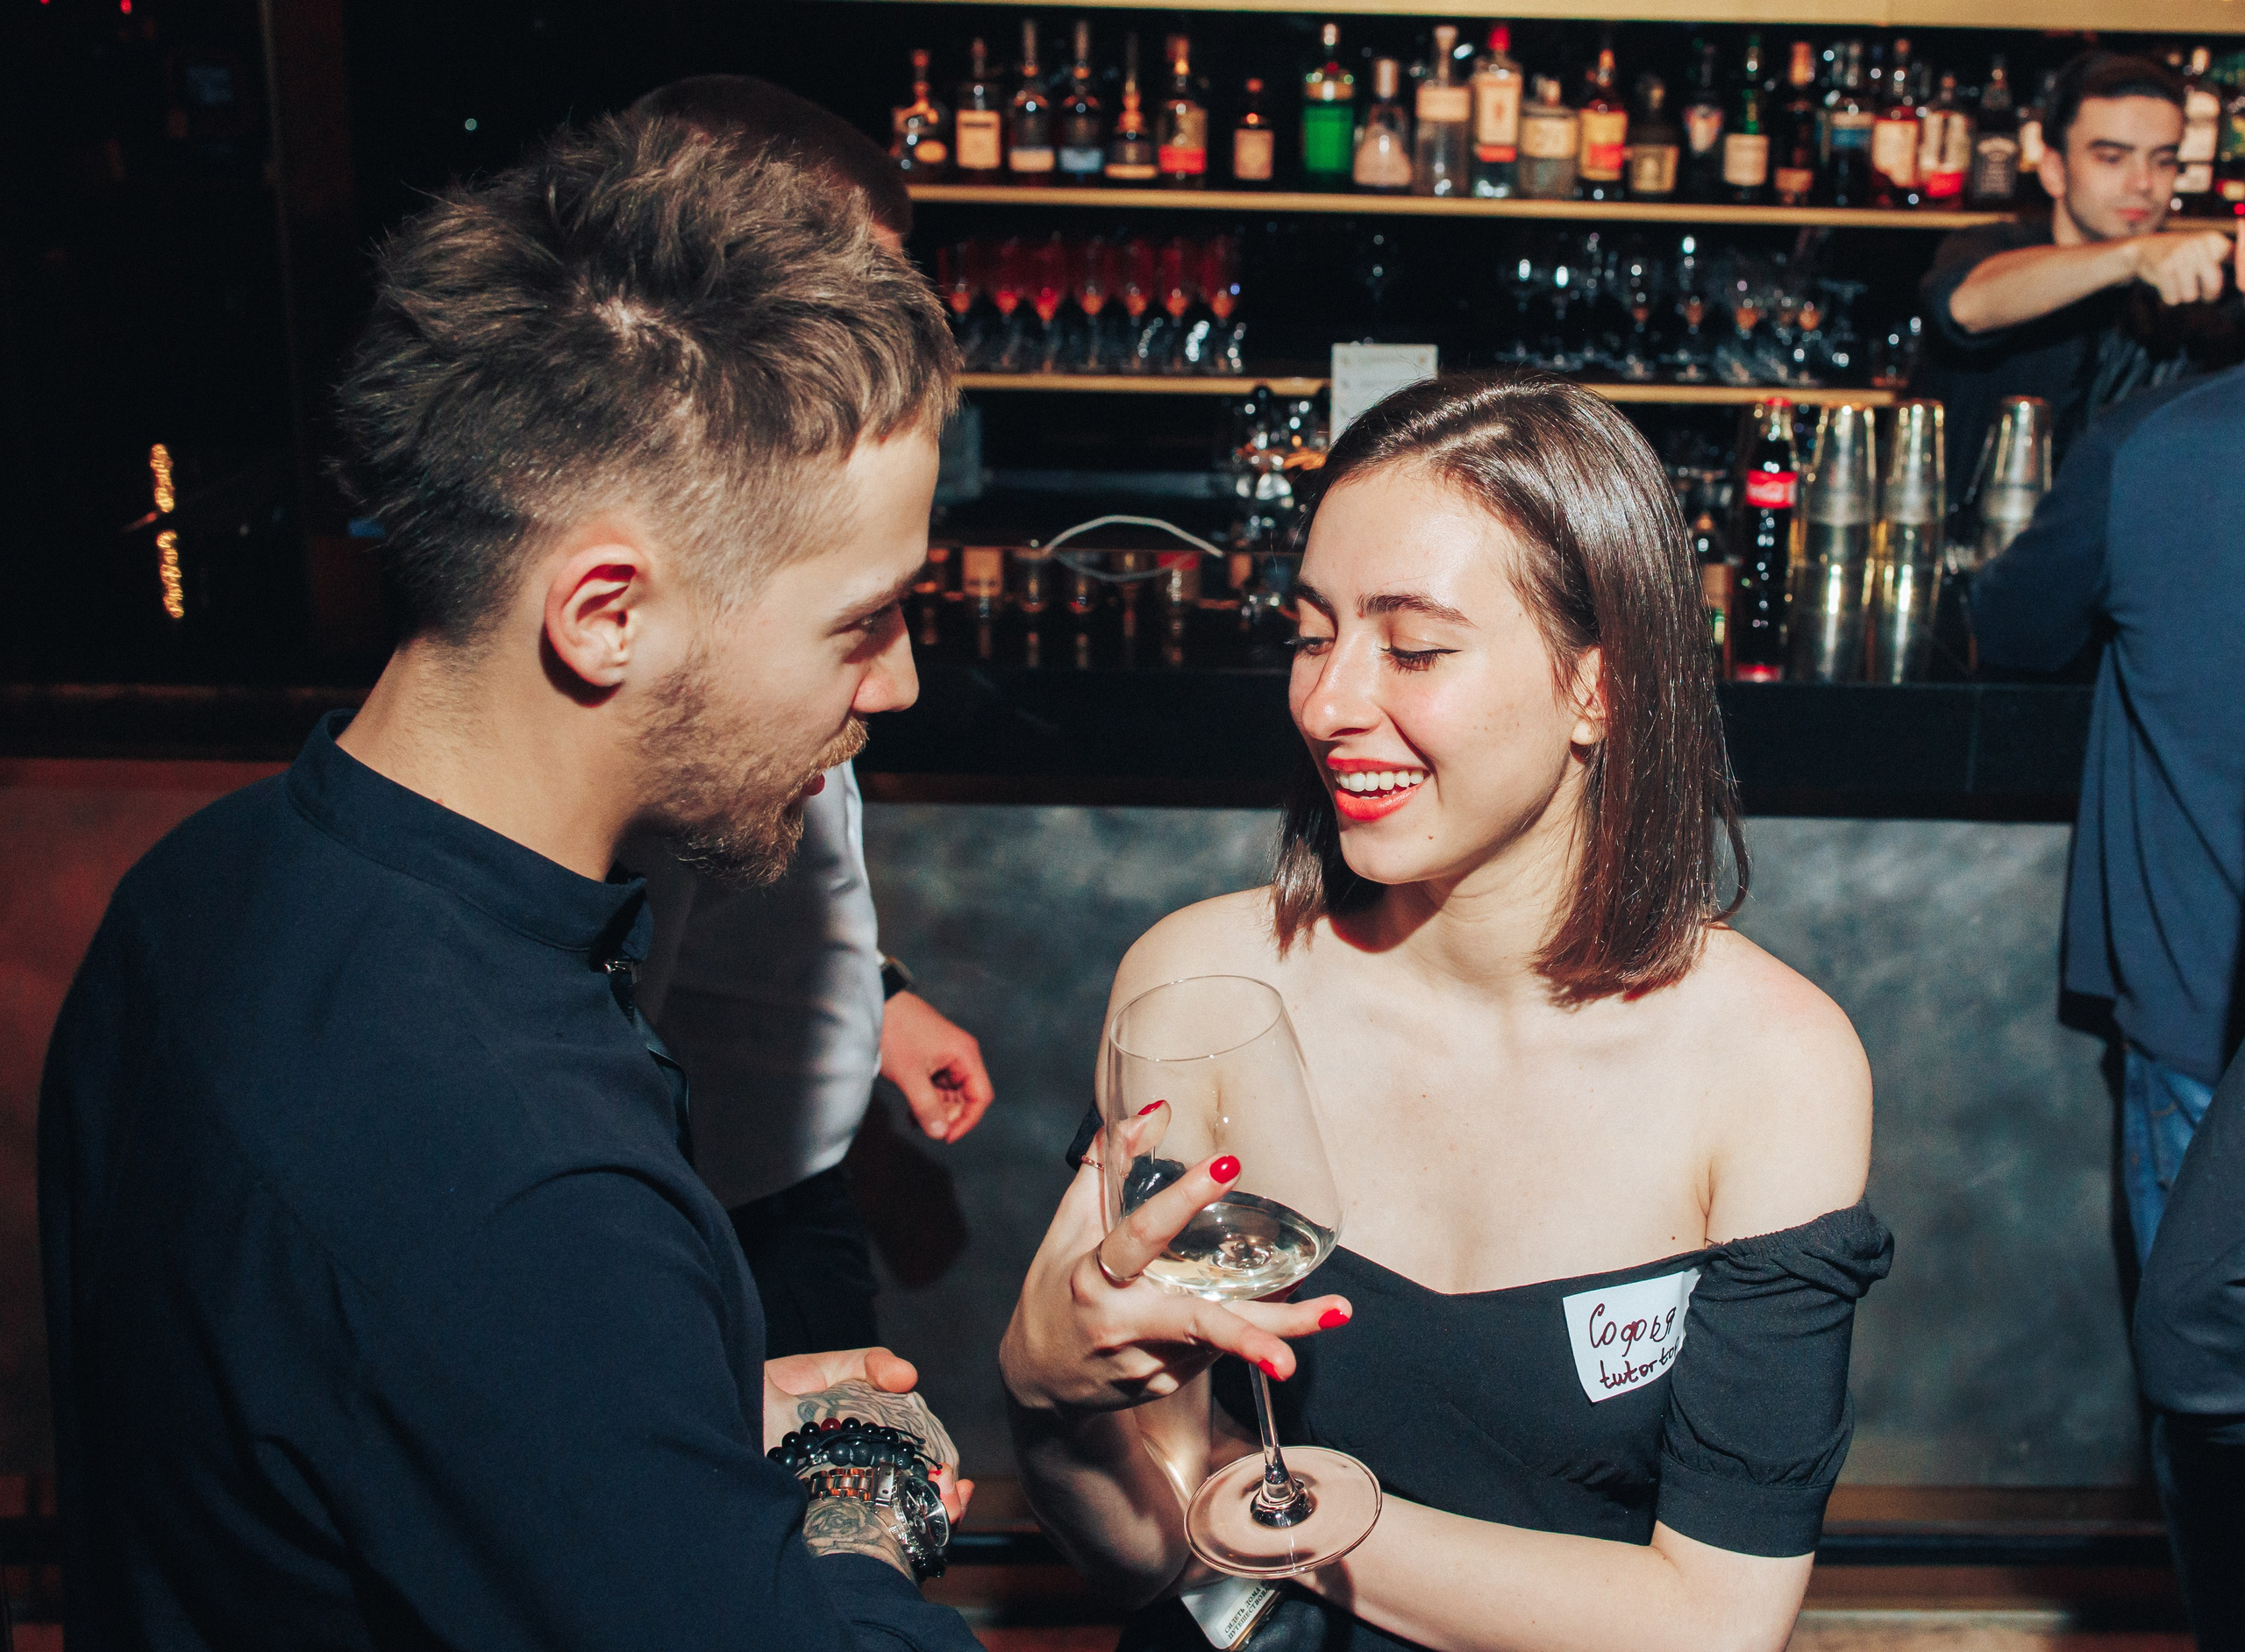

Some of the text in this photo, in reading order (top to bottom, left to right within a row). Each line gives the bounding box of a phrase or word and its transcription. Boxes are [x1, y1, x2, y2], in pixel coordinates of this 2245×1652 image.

[1589, 1302, 1677, 1357] Софья
[1224, 1587, 1262, 1634] СИДЕТЬ ДОМА
